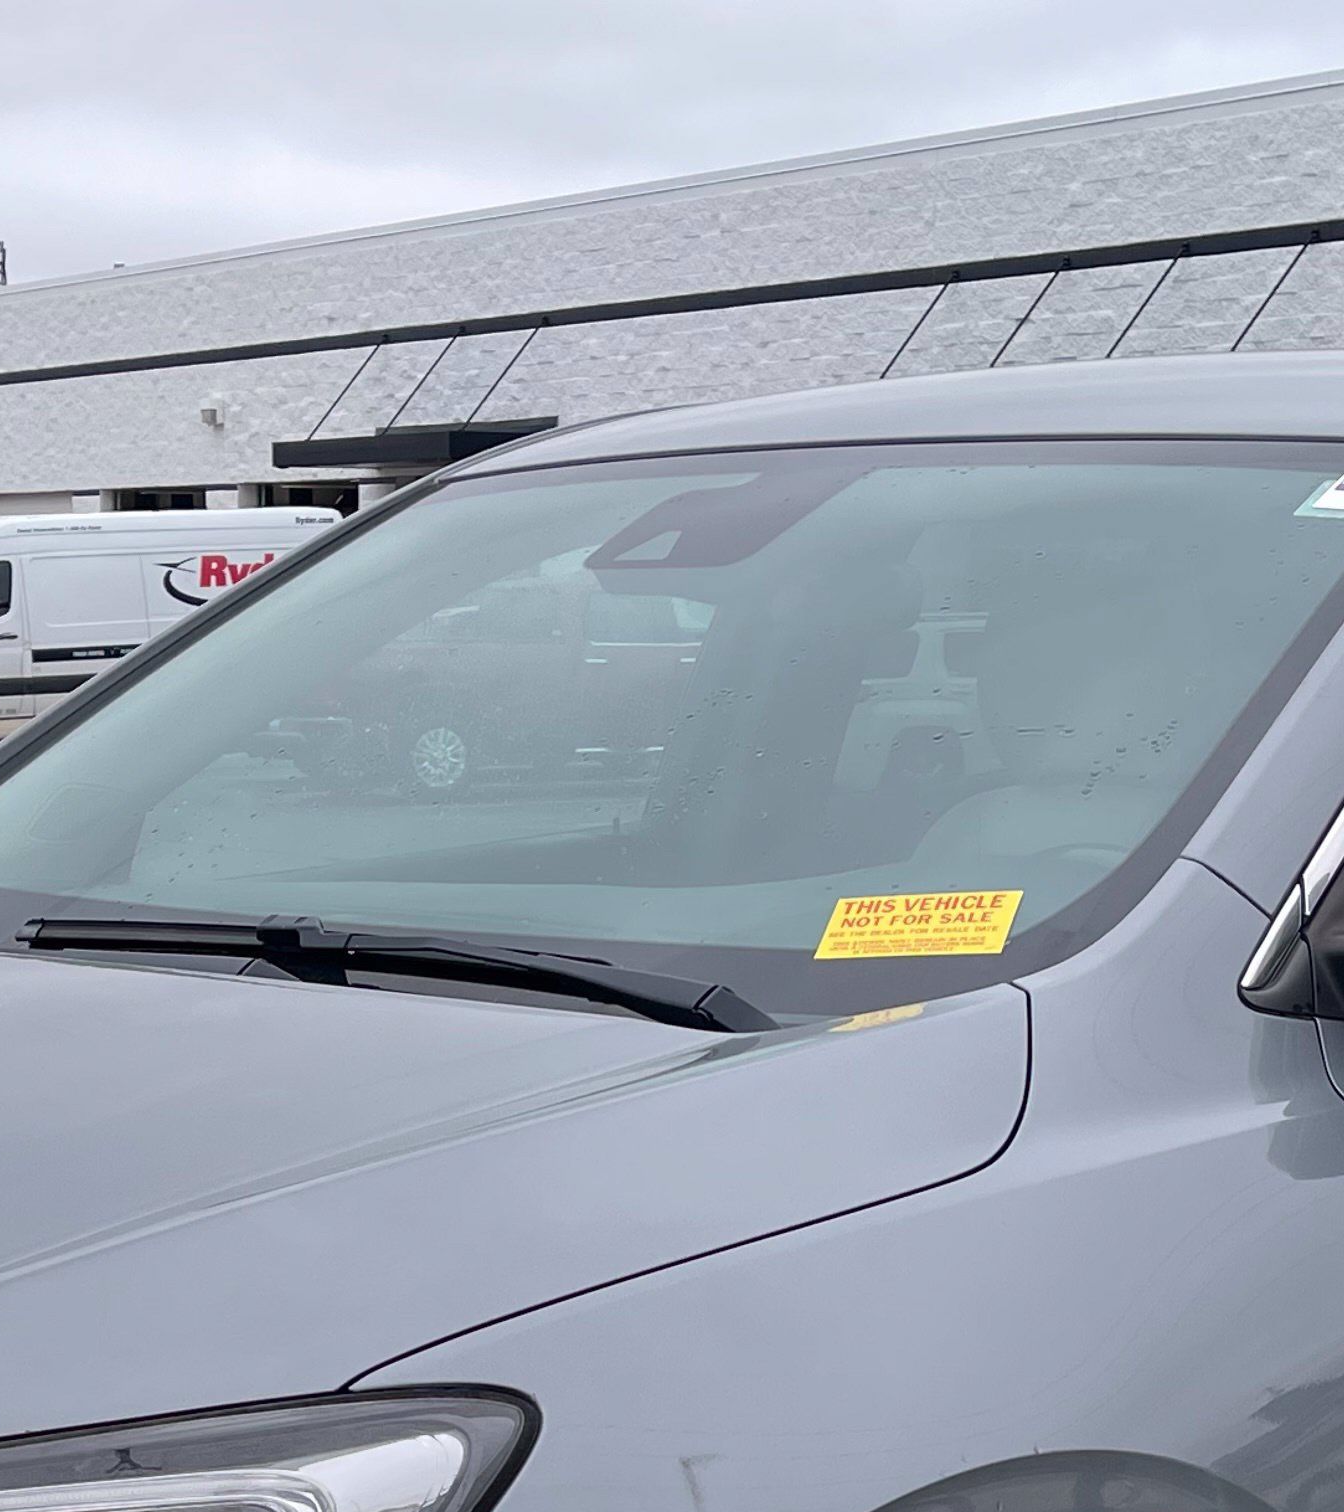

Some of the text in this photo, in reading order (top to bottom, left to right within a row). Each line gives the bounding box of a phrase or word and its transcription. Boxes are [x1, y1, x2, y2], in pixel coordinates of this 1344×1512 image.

[844, 894, 1007, 915] THIS VEHICLE
[840, 911, 995, 929] NOT FOR SALE
